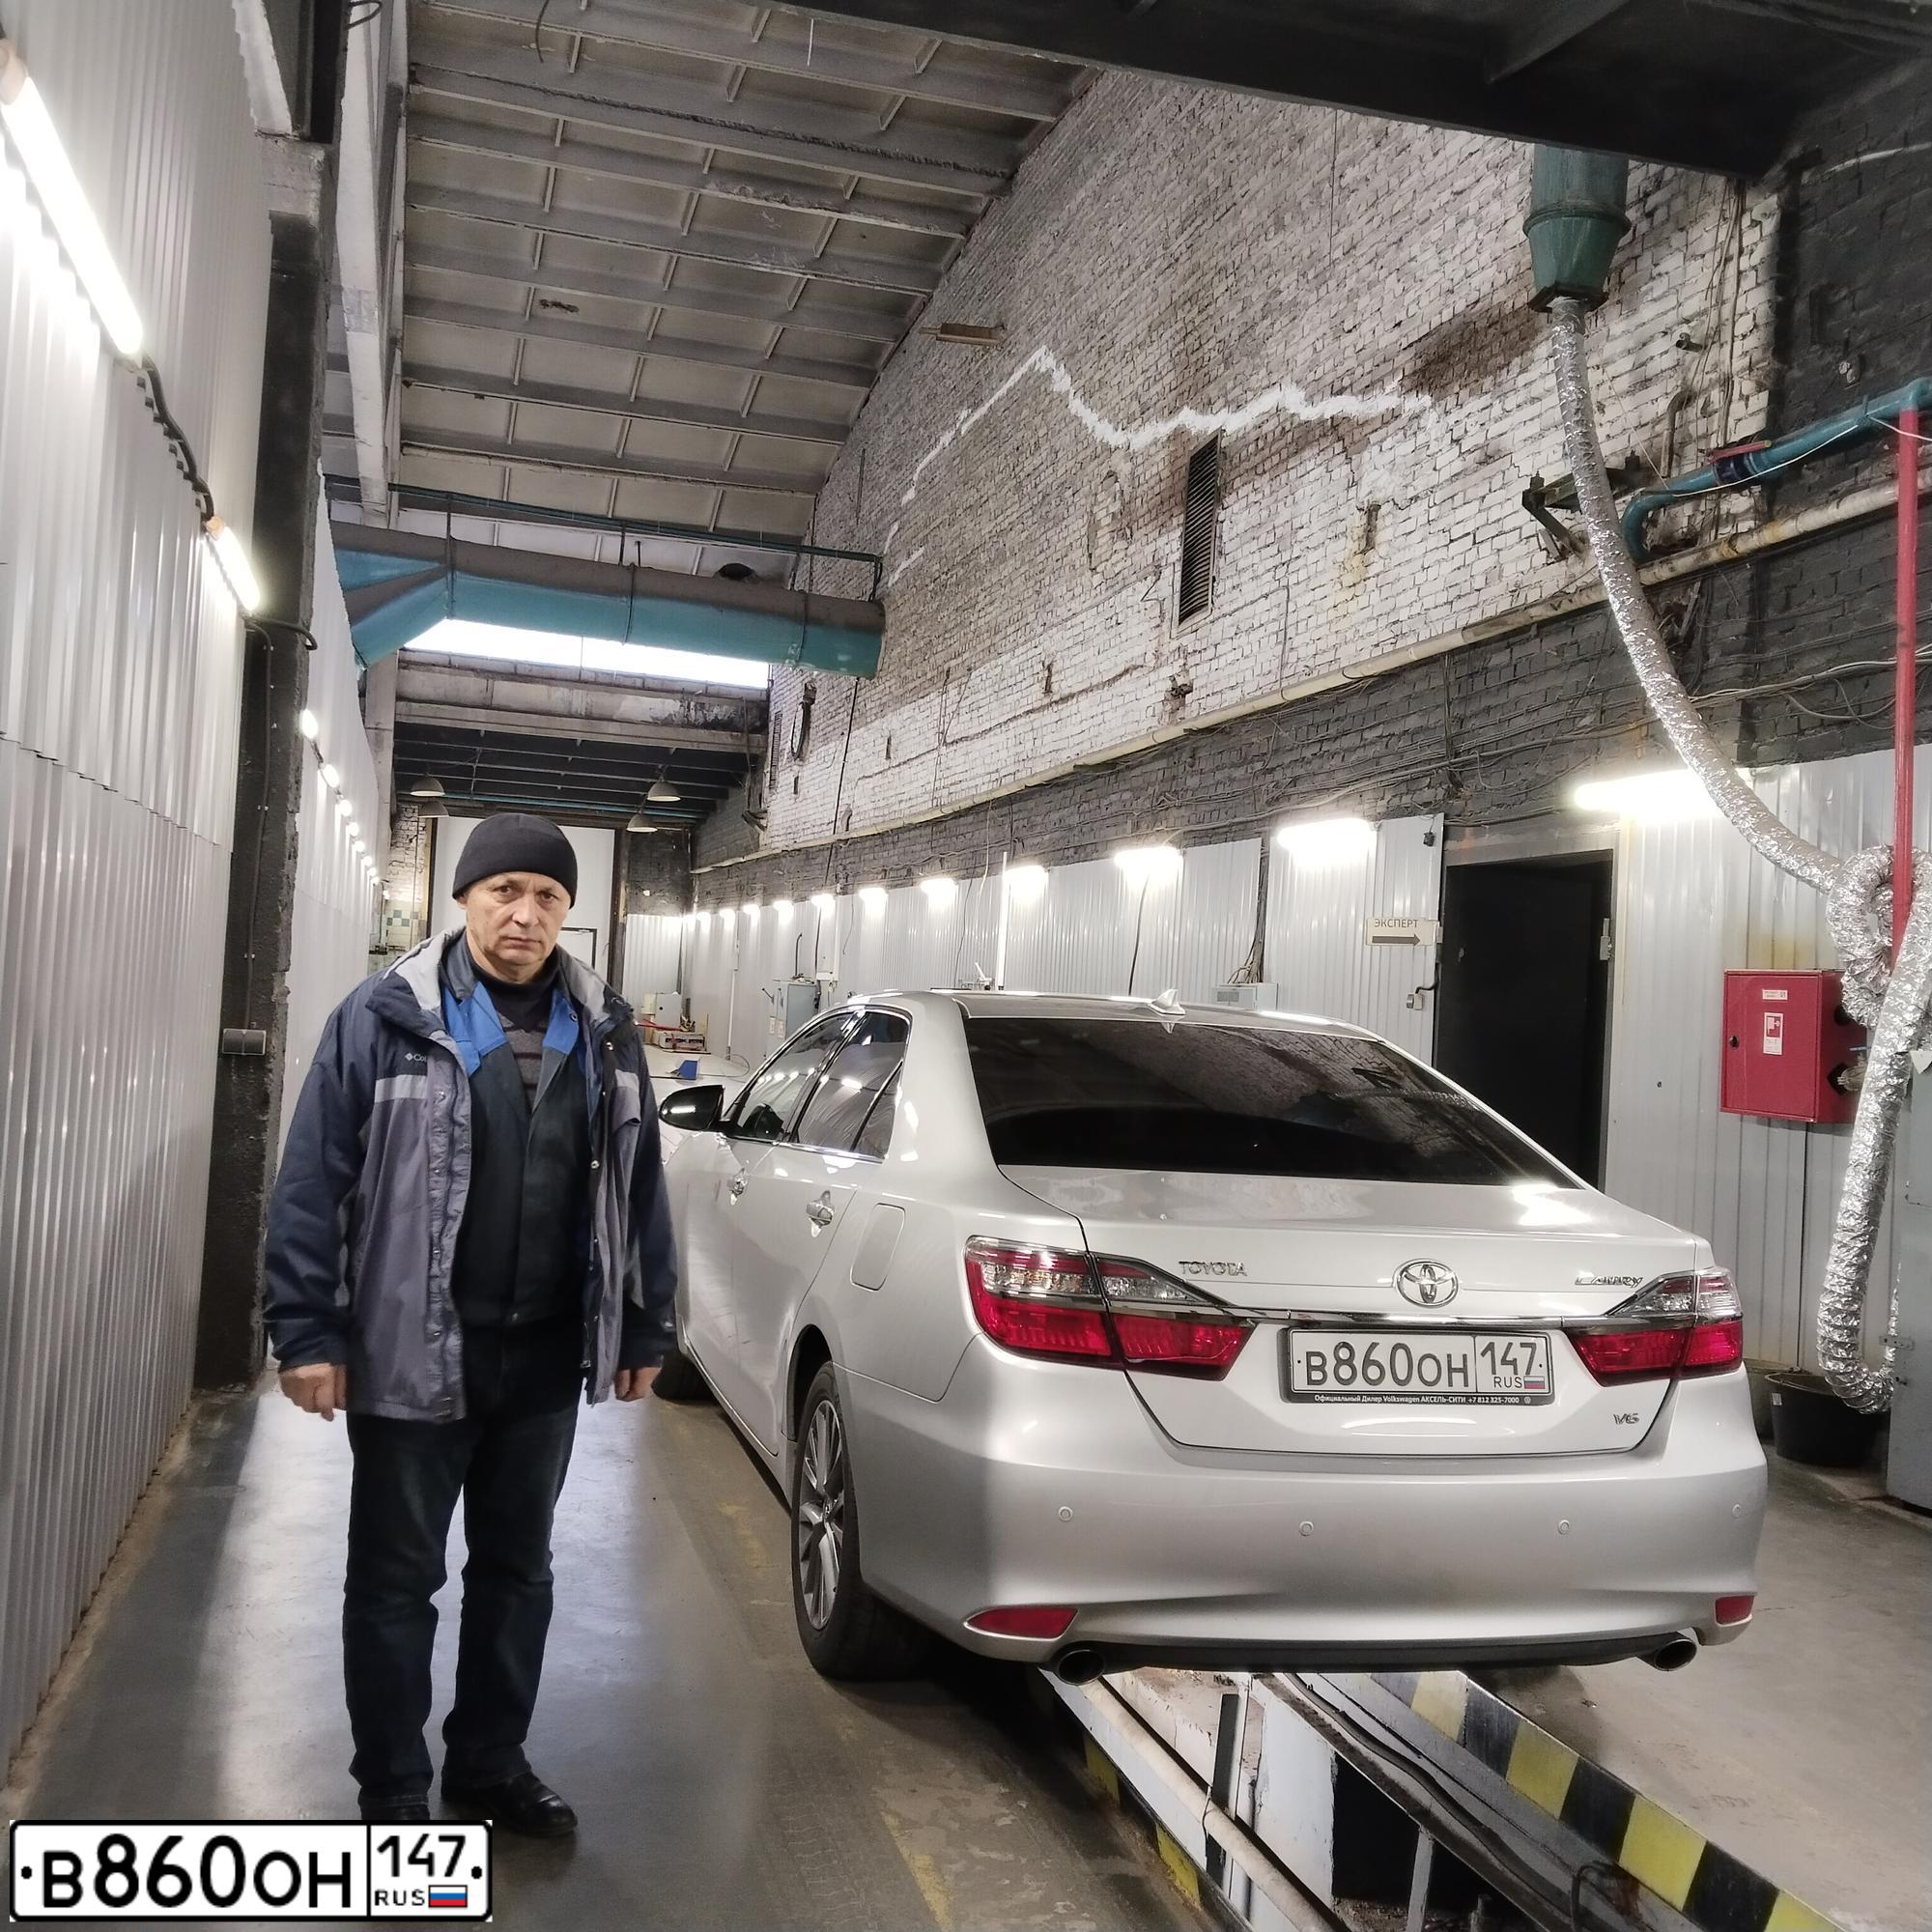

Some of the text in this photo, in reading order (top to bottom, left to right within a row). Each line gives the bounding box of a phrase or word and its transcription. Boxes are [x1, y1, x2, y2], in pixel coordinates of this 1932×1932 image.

[1374, 918, 1419, 928] ЭКСПЕРТ
[1179, 1261, 1247, 1276] TOYOTA
[1480, 1341, 1537, 1375] 147
[1493, 1376, 1522, 1388] RUS
[1314, 1394, 1361, 1403] Официальный
[1361, 1395, 1382, 1404] Дилер
[1382, 1395, 1420, 1404] Volkswagen
